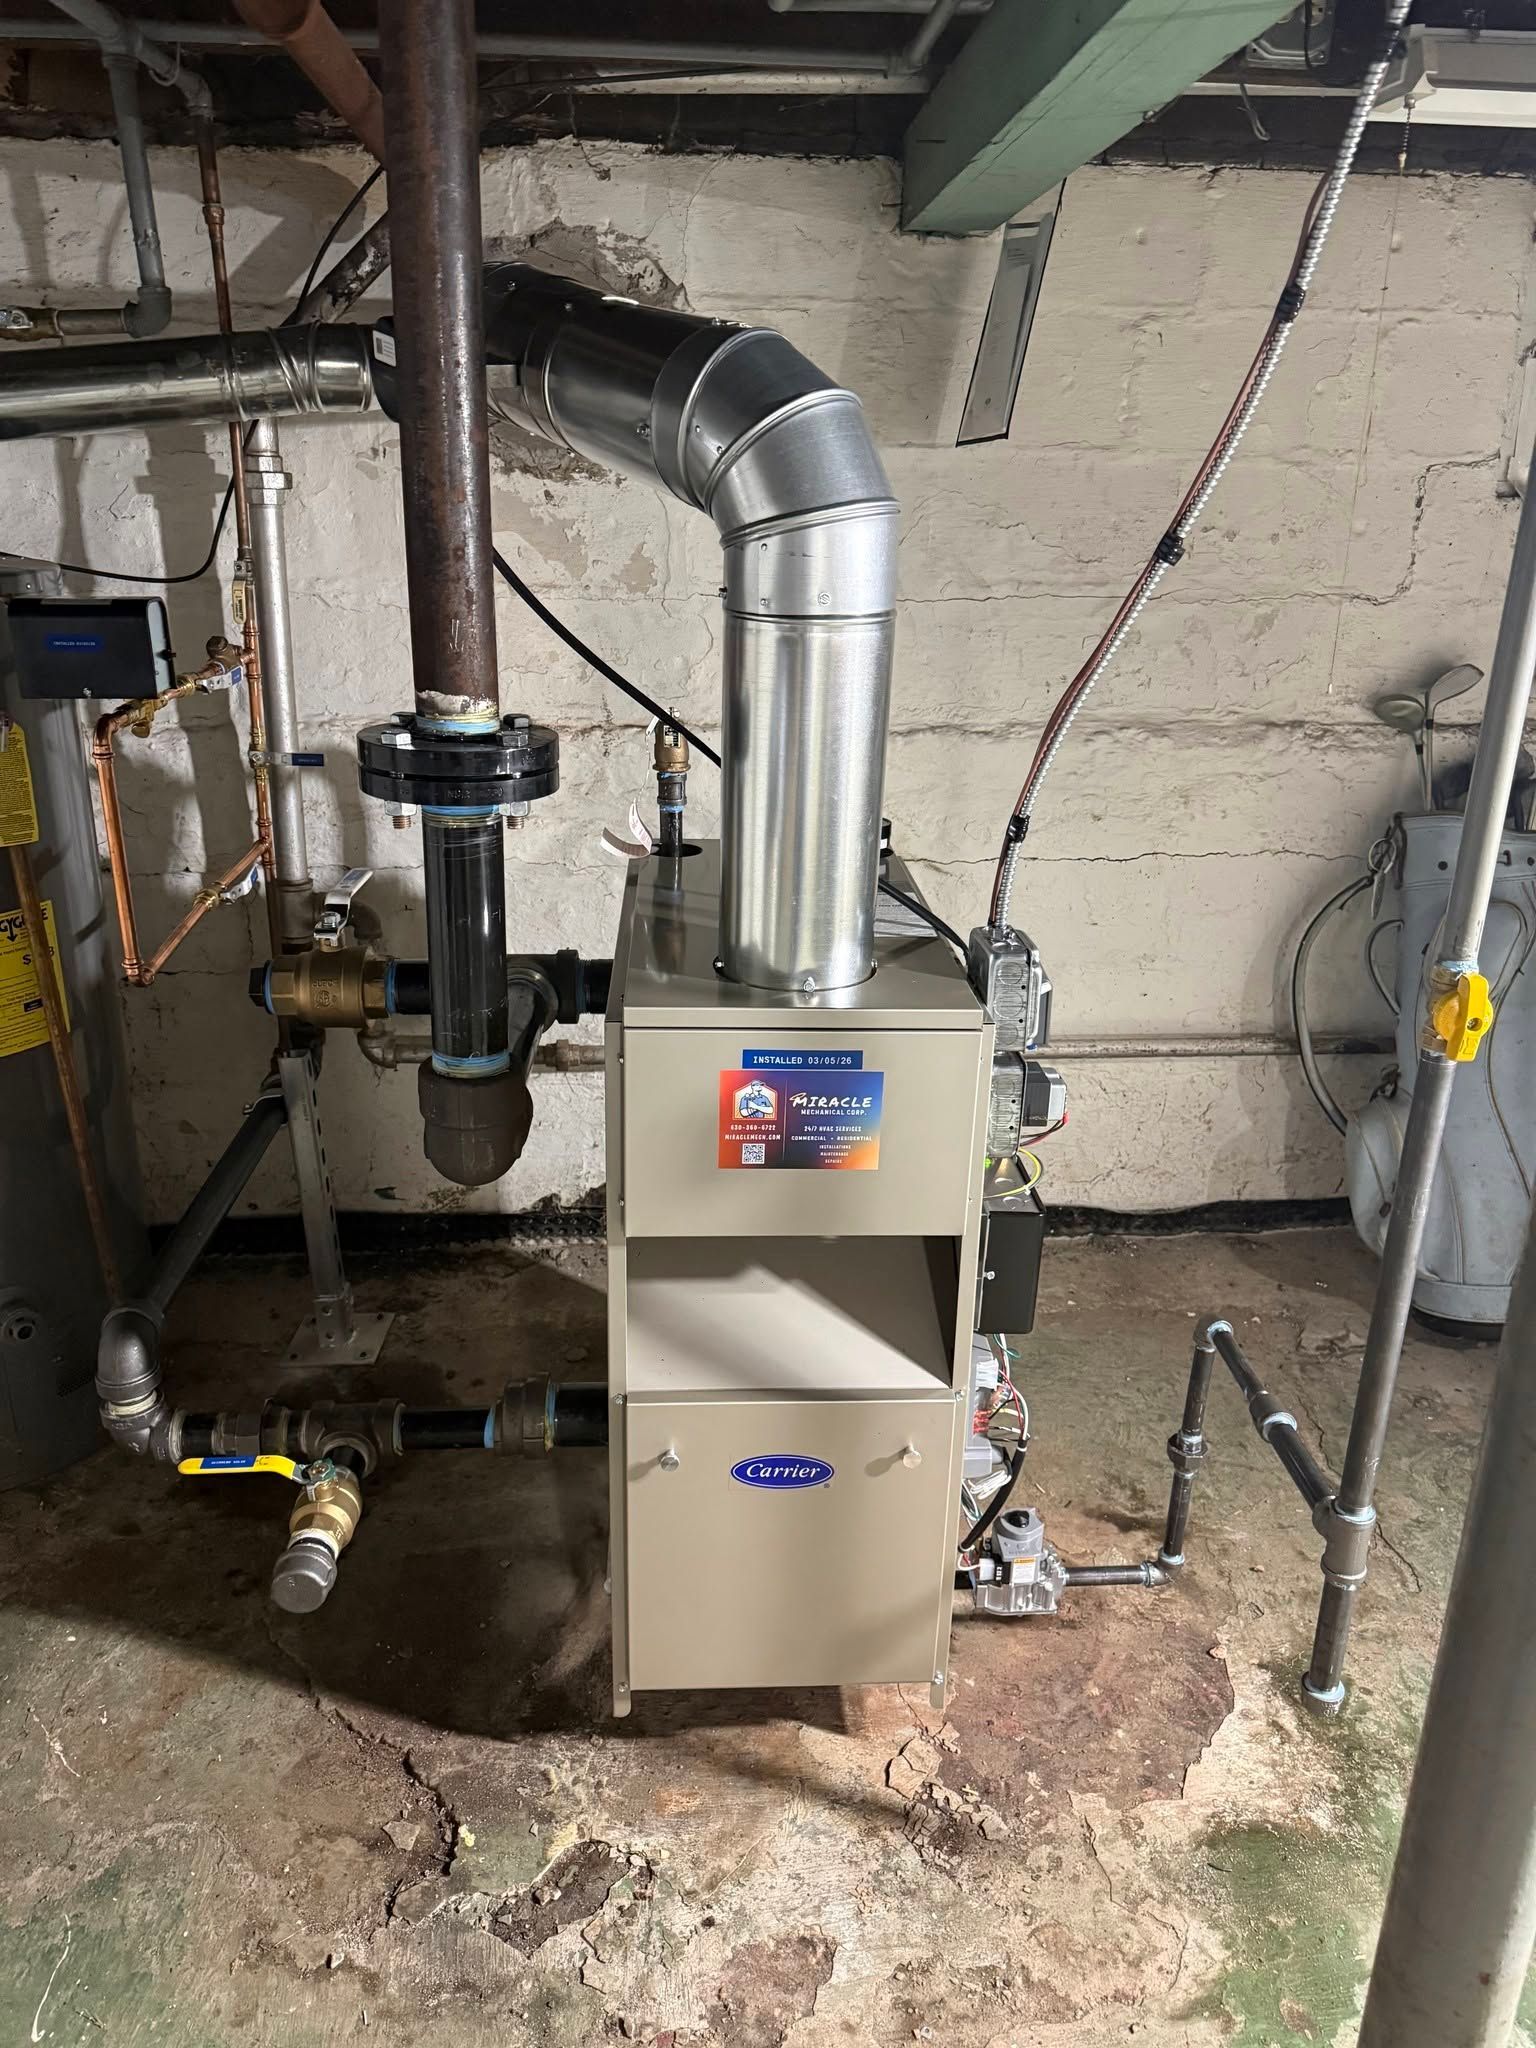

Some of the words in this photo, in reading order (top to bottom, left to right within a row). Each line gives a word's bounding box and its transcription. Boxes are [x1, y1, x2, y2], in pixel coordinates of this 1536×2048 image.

[753, 1056, 803, 1065] INSTALLED
[808, 1056, 852, 1065] 03/05/26
[790, 1094, 873, 1108] MIRACLE
[746, 1463, 820, 1478] Carrier
